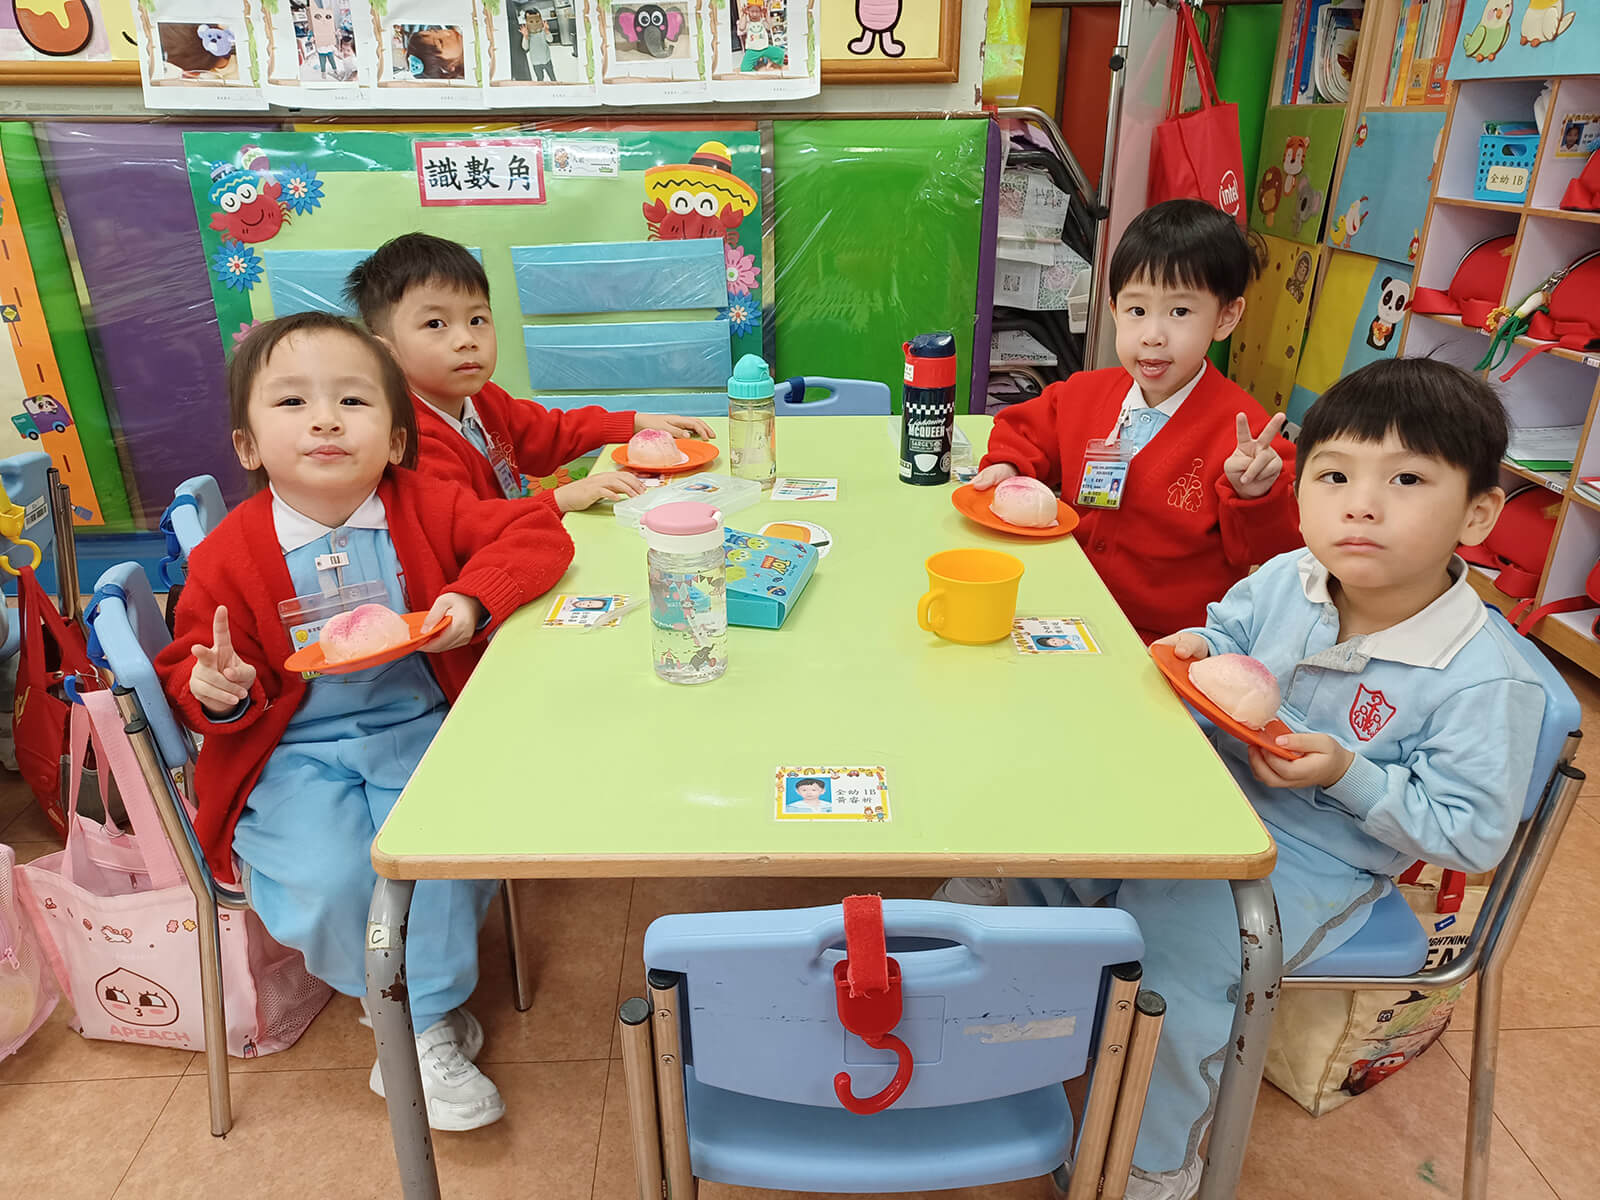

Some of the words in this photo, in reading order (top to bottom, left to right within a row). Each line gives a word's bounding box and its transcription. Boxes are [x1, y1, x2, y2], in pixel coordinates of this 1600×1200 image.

[424, 155, 531, 191] 識數角
[1489, 173, 1510, 185] 全幼
[1220, 180, 1239, 206] intel
[771, 559, 791, 575] TOY
[371, 929, 385, 944] C
[110, 1023, 192, 1042] APEACH
